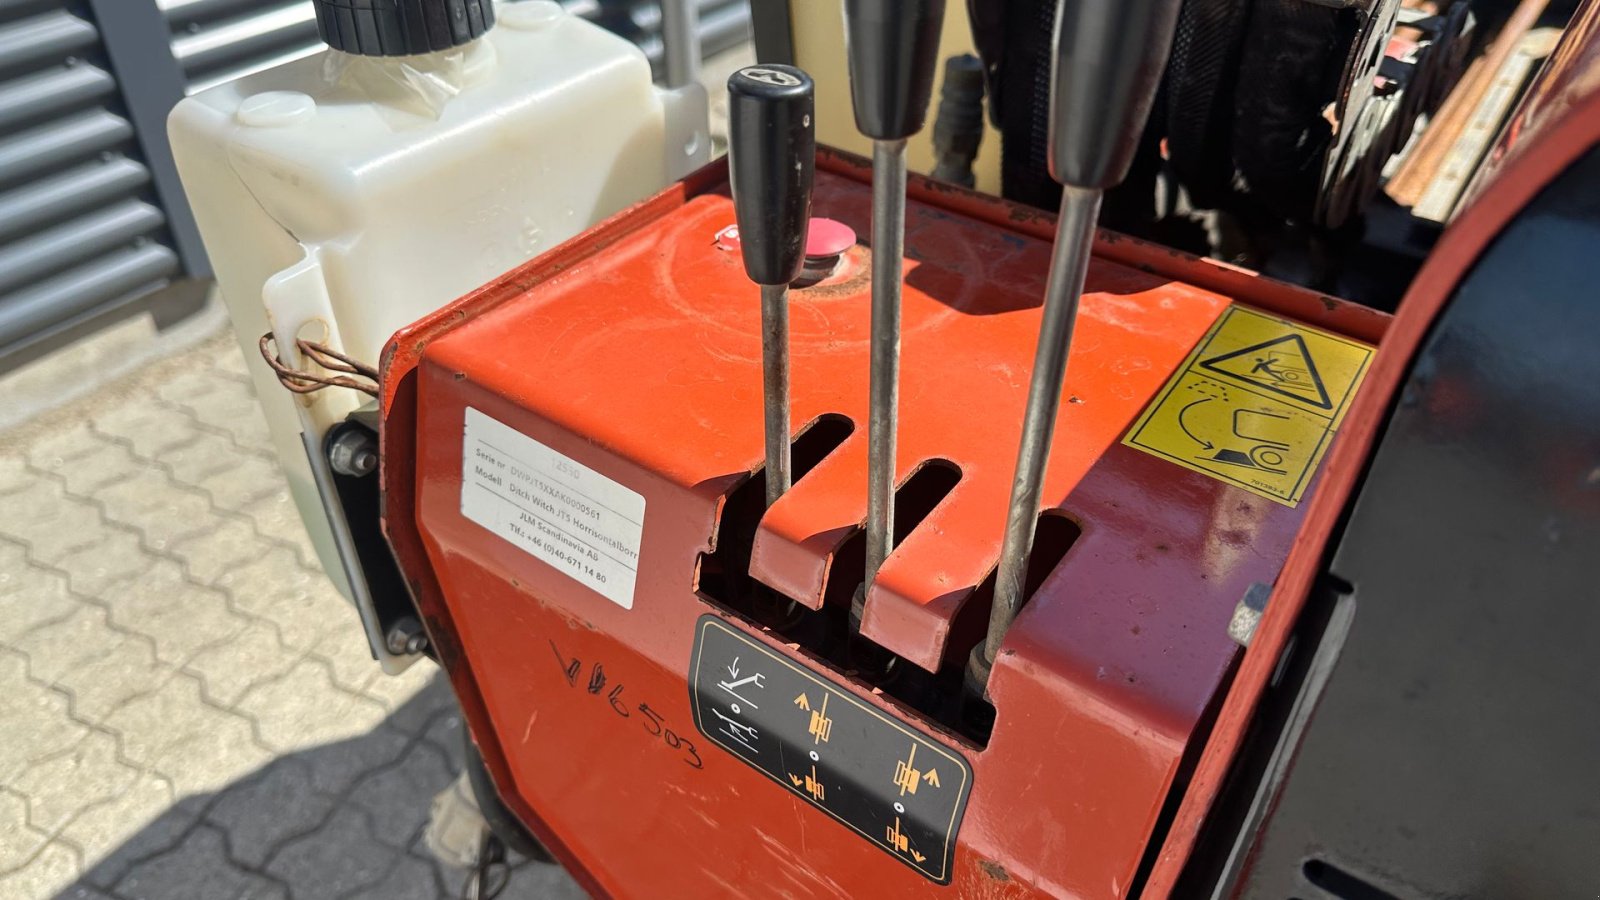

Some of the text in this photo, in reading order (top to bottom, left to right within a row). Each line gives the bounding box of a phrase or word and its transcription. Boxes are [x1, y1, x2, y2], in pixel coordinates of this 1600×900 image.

[475, 448, 496, 464] Serie
[497, 461, 506, 469] nr
[475, 466, 502, 487] Modell
[510, 482, 531, 502] Ditch
[532, 495, 555, 515] Witch
[520, 512, 599, 562] JLM Scandinavia AB
[527, 535, 542, 547] +46
[543, 543, 582, 569] (0)40-671
[584, 565, 594, 576] 14
[596, 573, 607, 583] 80
